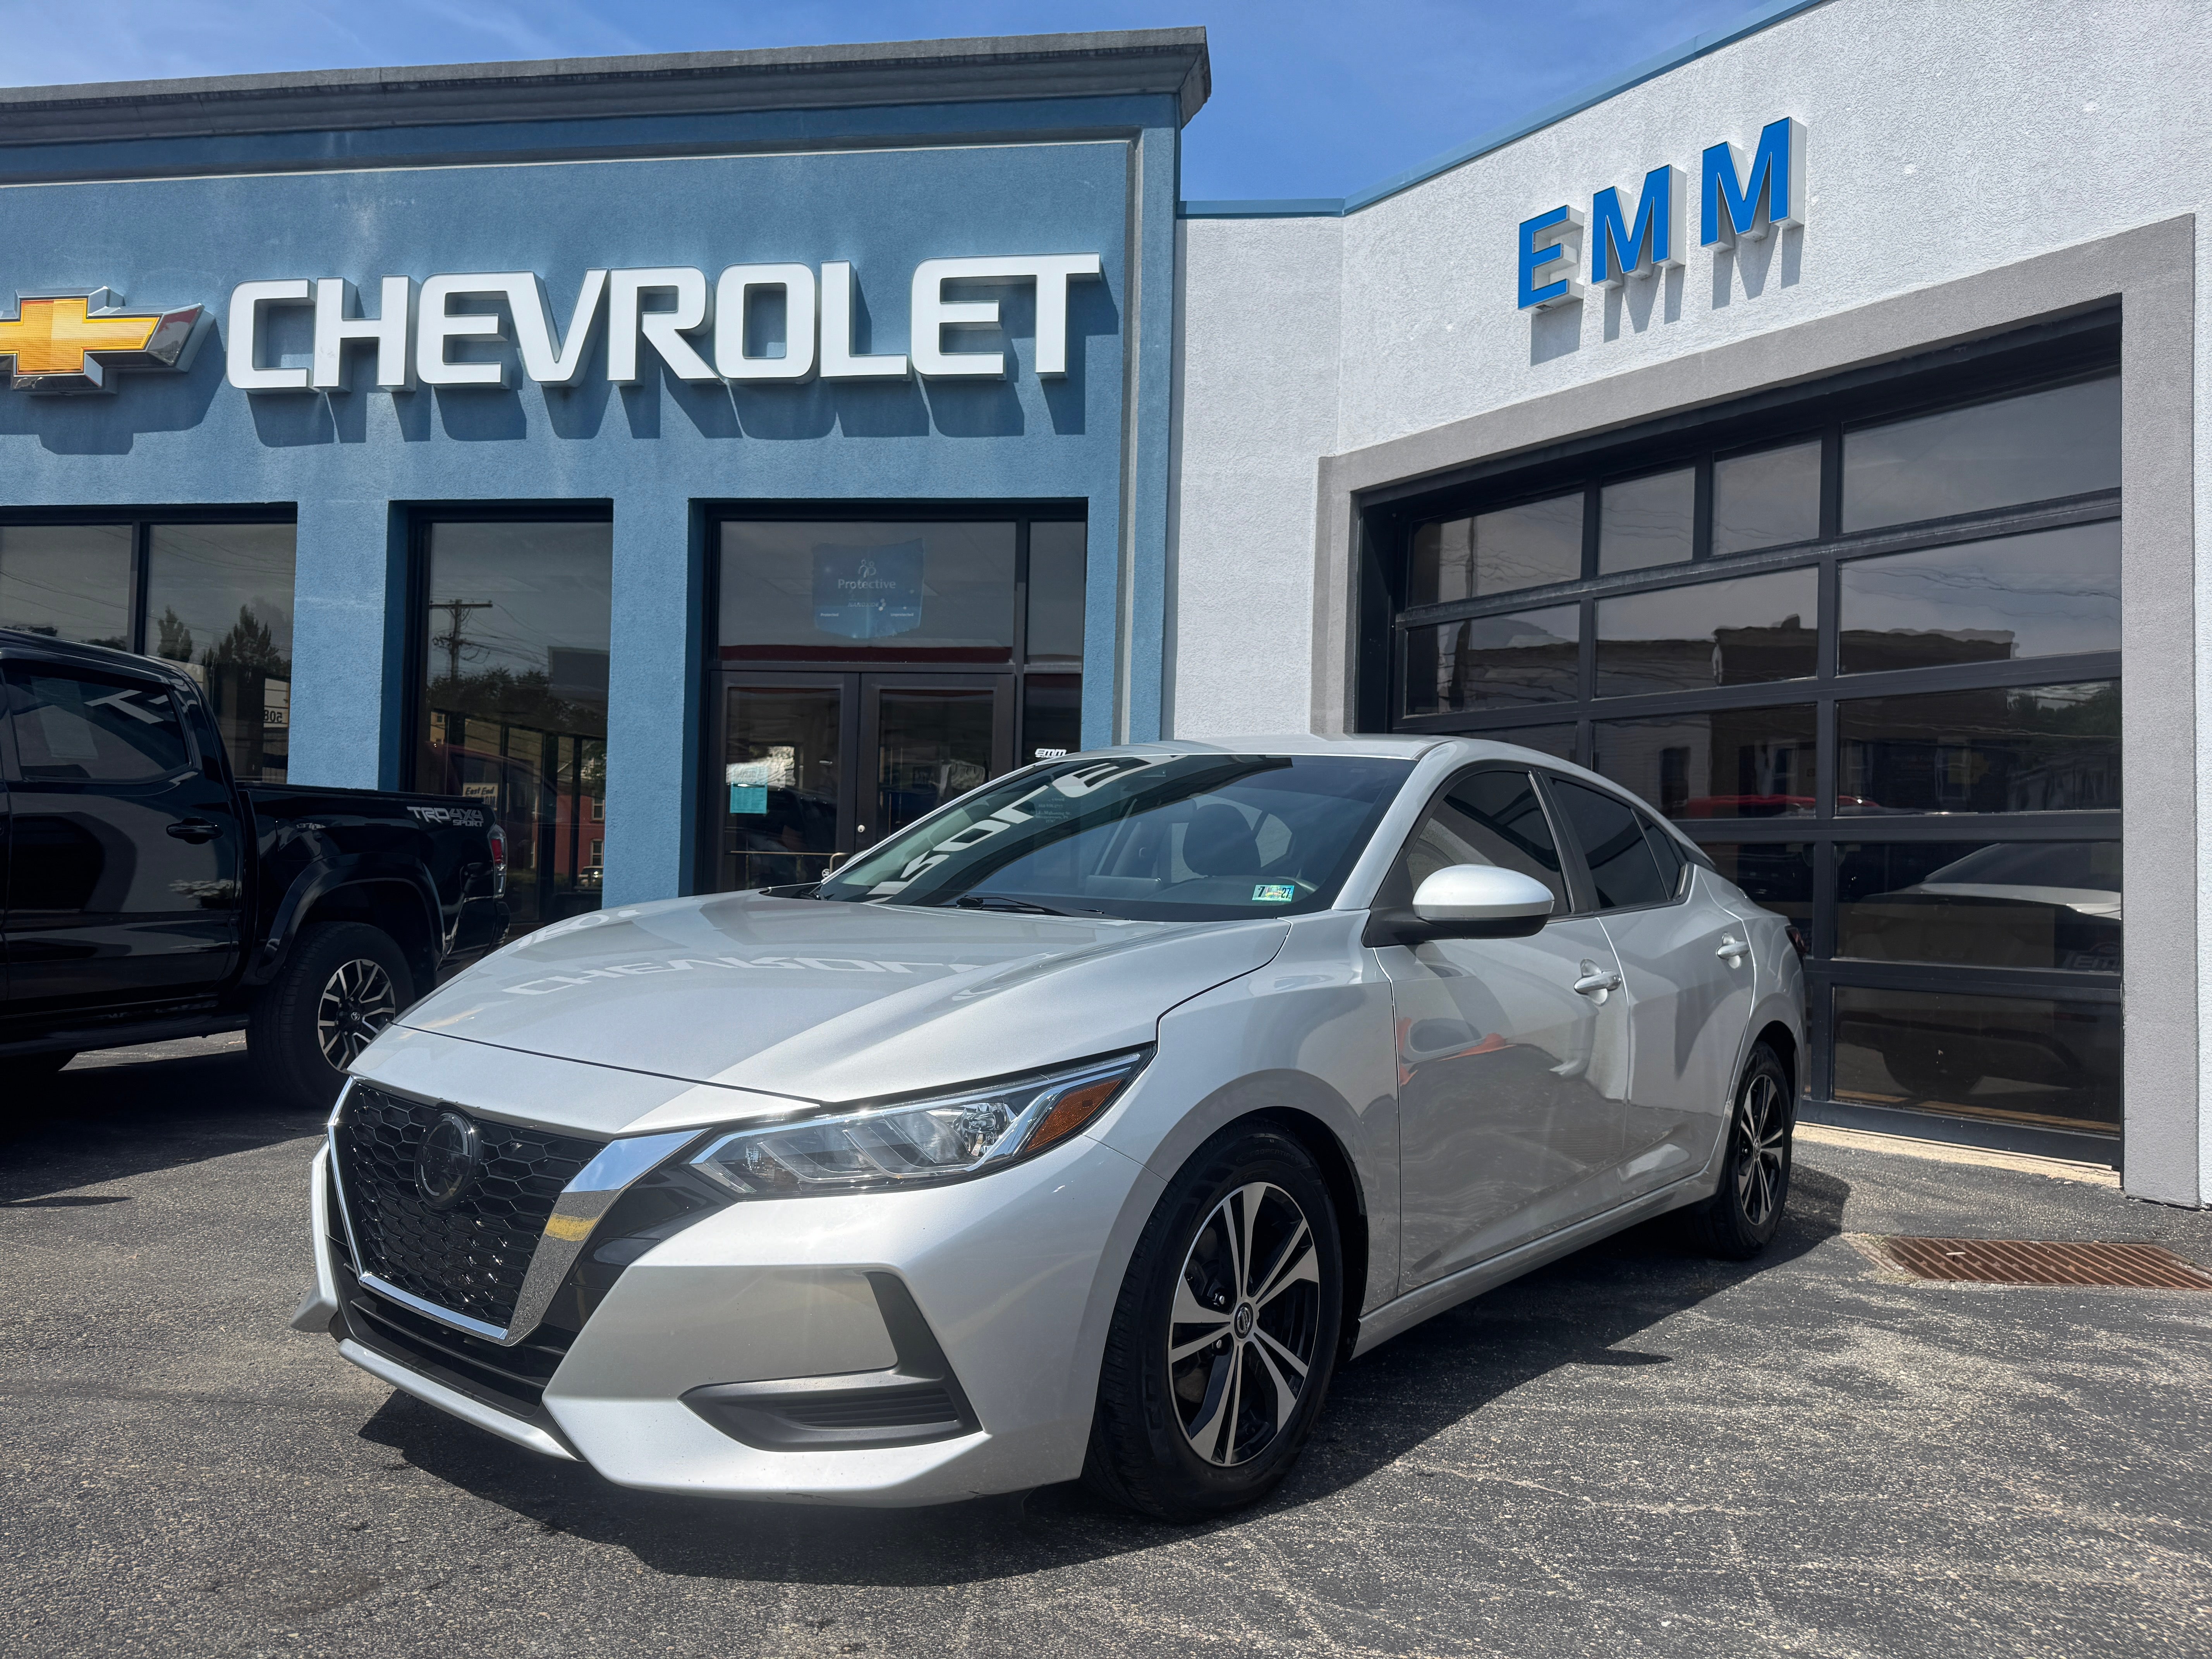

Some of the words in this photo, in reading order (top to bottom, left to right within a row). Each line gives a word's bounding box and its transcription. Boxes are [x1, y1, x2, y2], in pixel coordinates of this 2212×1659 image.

[1518, 117, 1799, 311] EMM
[227, 252, 1101, 392] CHEVROLET
[838, 579, 896, 589] Protective
[407, 806, 451, 824] TRD
[1281, 887, 1291, 898] 27
